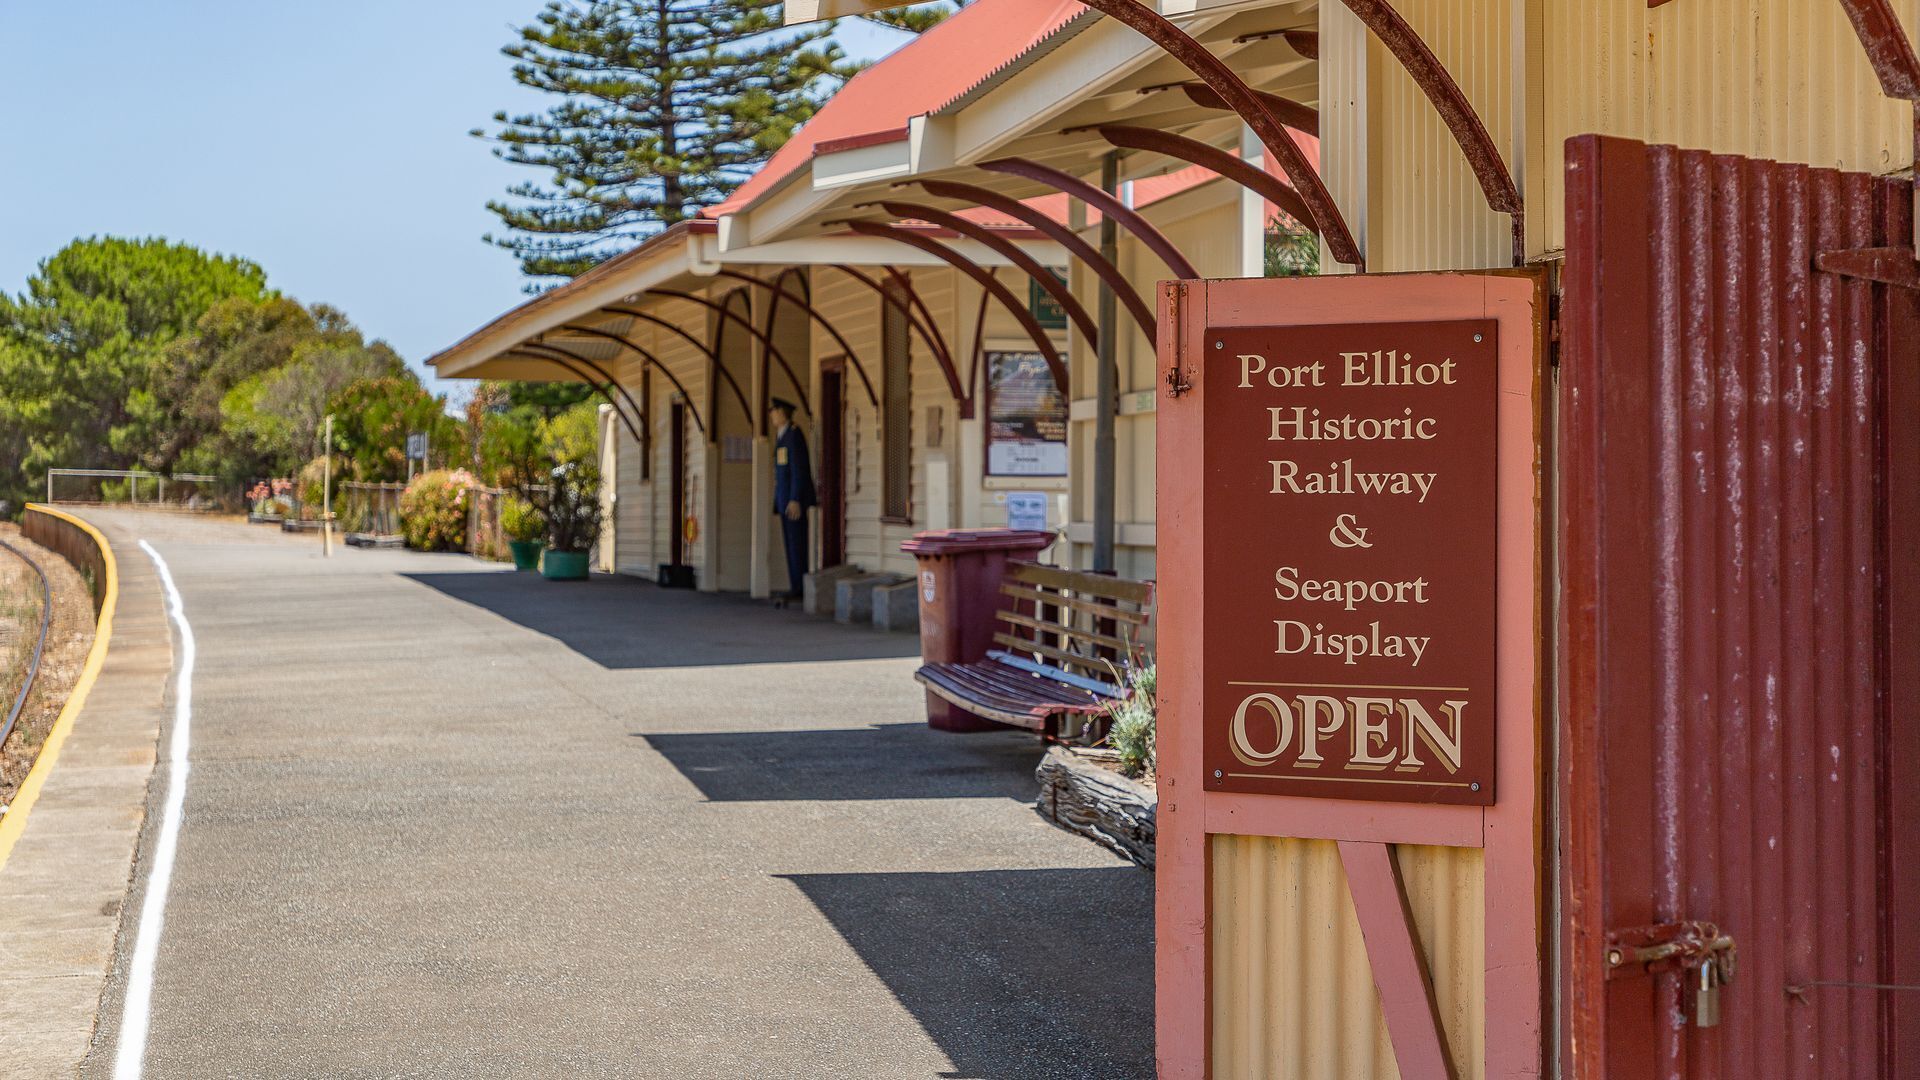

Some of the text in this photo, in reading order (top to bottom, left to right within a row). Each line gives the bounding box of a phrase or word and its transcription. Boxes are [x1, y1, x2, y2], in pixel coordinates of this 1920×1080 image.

[1236, 349, 1457, 388] Port Elliot
[1266, 406, 1438, 441] Historic
[1268, 457, 1437, 504] Railway
[1329, 513, 1374, 549] &
[1274, 566, 1430, 611] Seaport
[1273, 619, 1431, 667] Display
[1228, 692, 1469, 775] OPEN
